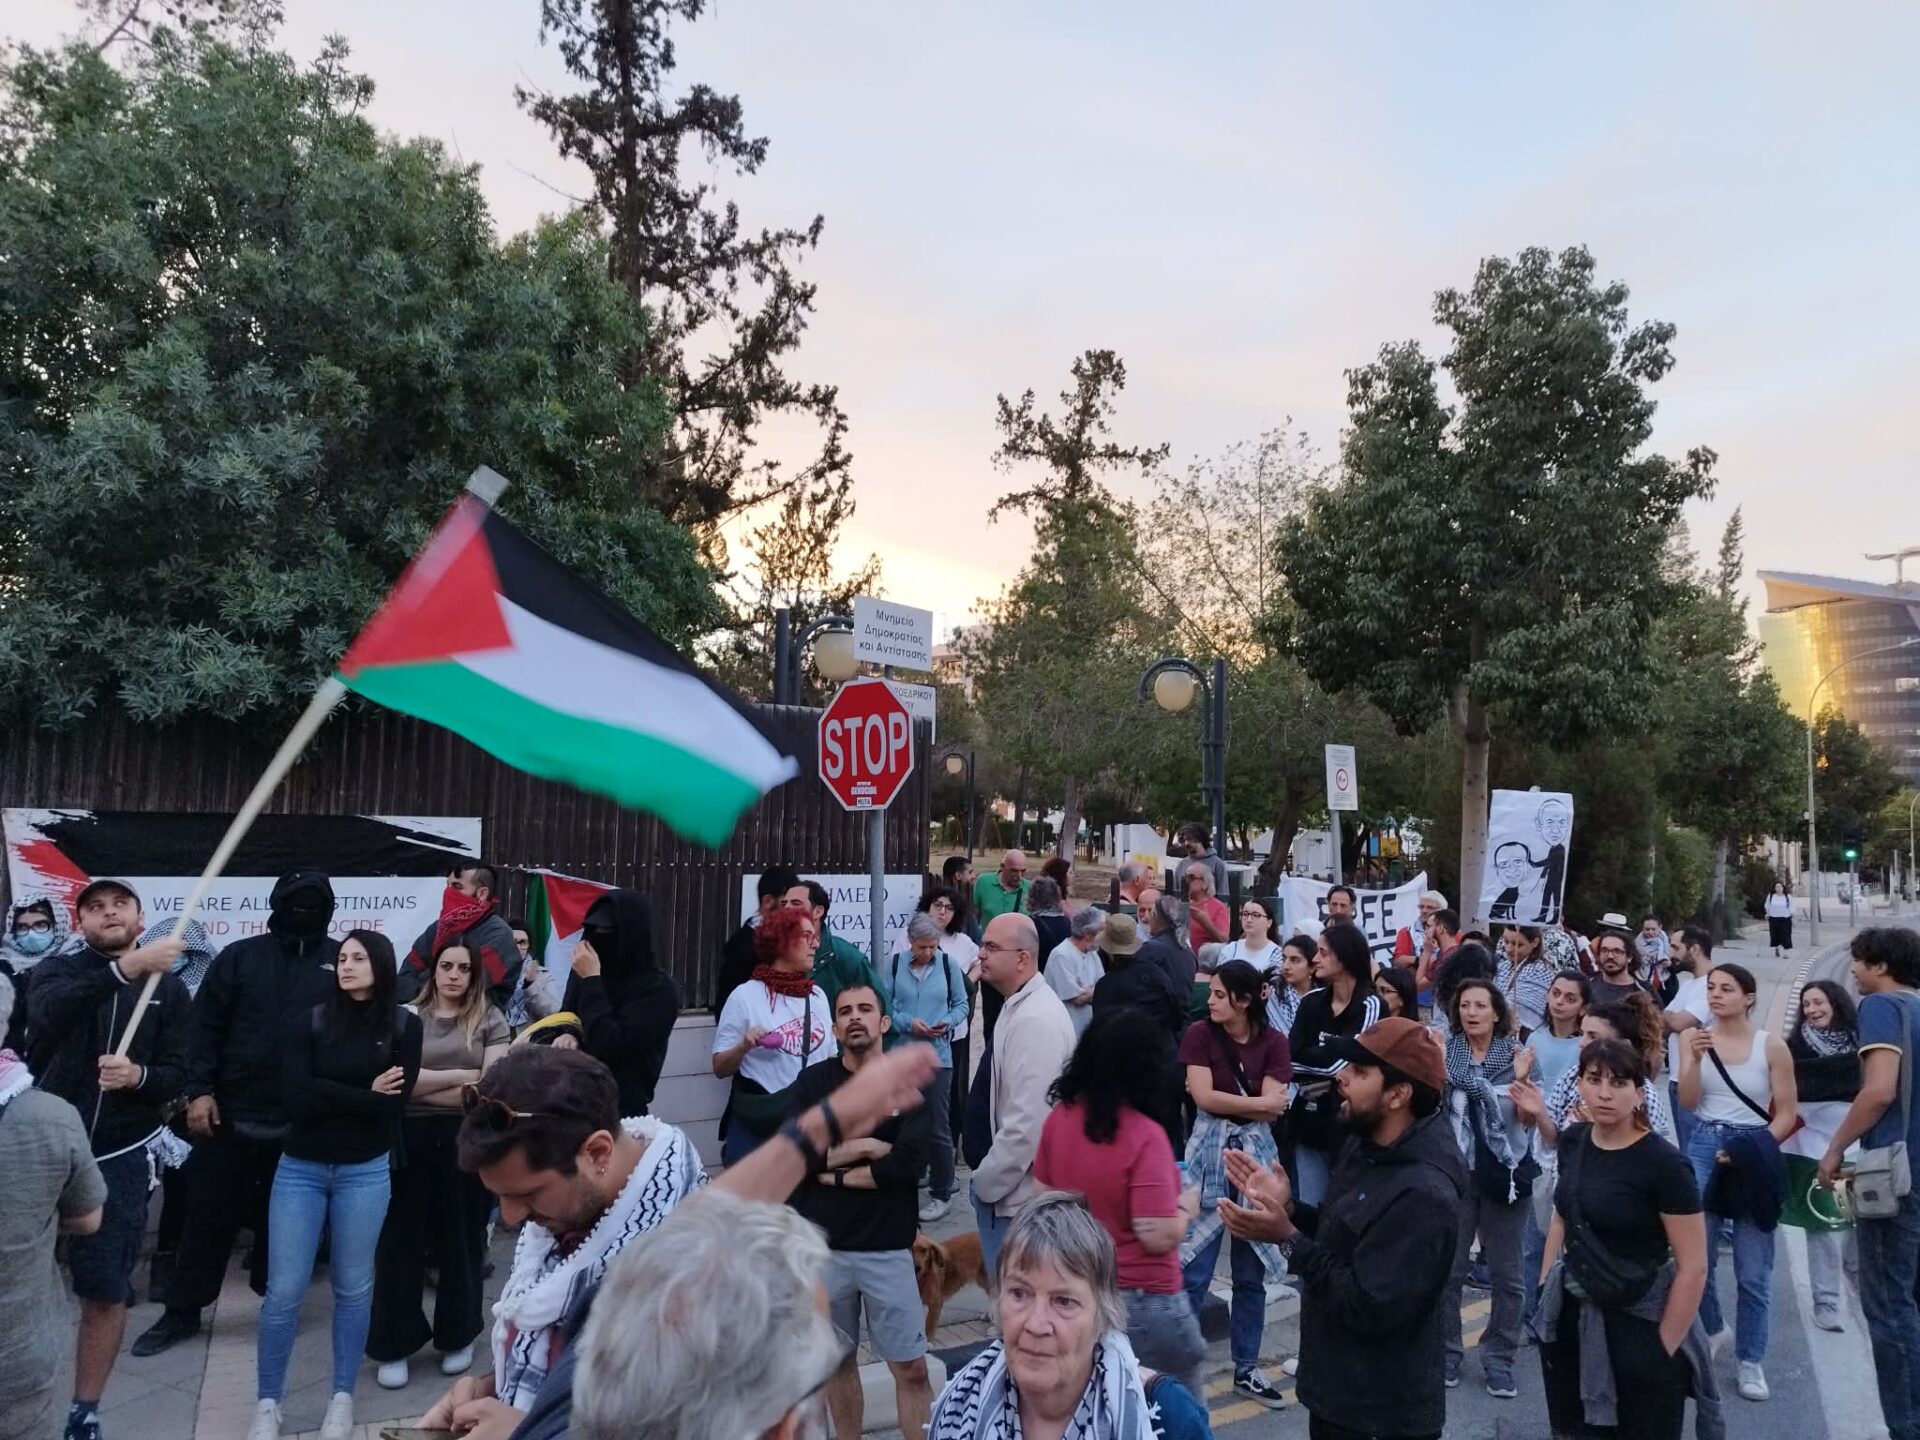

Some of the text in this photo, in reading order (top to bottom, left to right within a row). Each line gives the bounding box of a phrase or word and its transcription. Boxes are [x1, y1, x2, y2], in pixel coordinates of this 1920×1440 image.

[864, 623, 924, 647] Δημοκρατίας
[859, 641, 928, 664] και Αντίστασης
[894, 687, 933, 700] ΡΟΕΔΡΙΚΟΥ
[825, 711, 908, 779] STOP
[153, 895, 417, 912] WE ARE ALL STINIANS
[202, 920, 230, 935] ND
[327, 918, 385, 934] OCIDE
[1316, 893, 1397, 940] FEE
